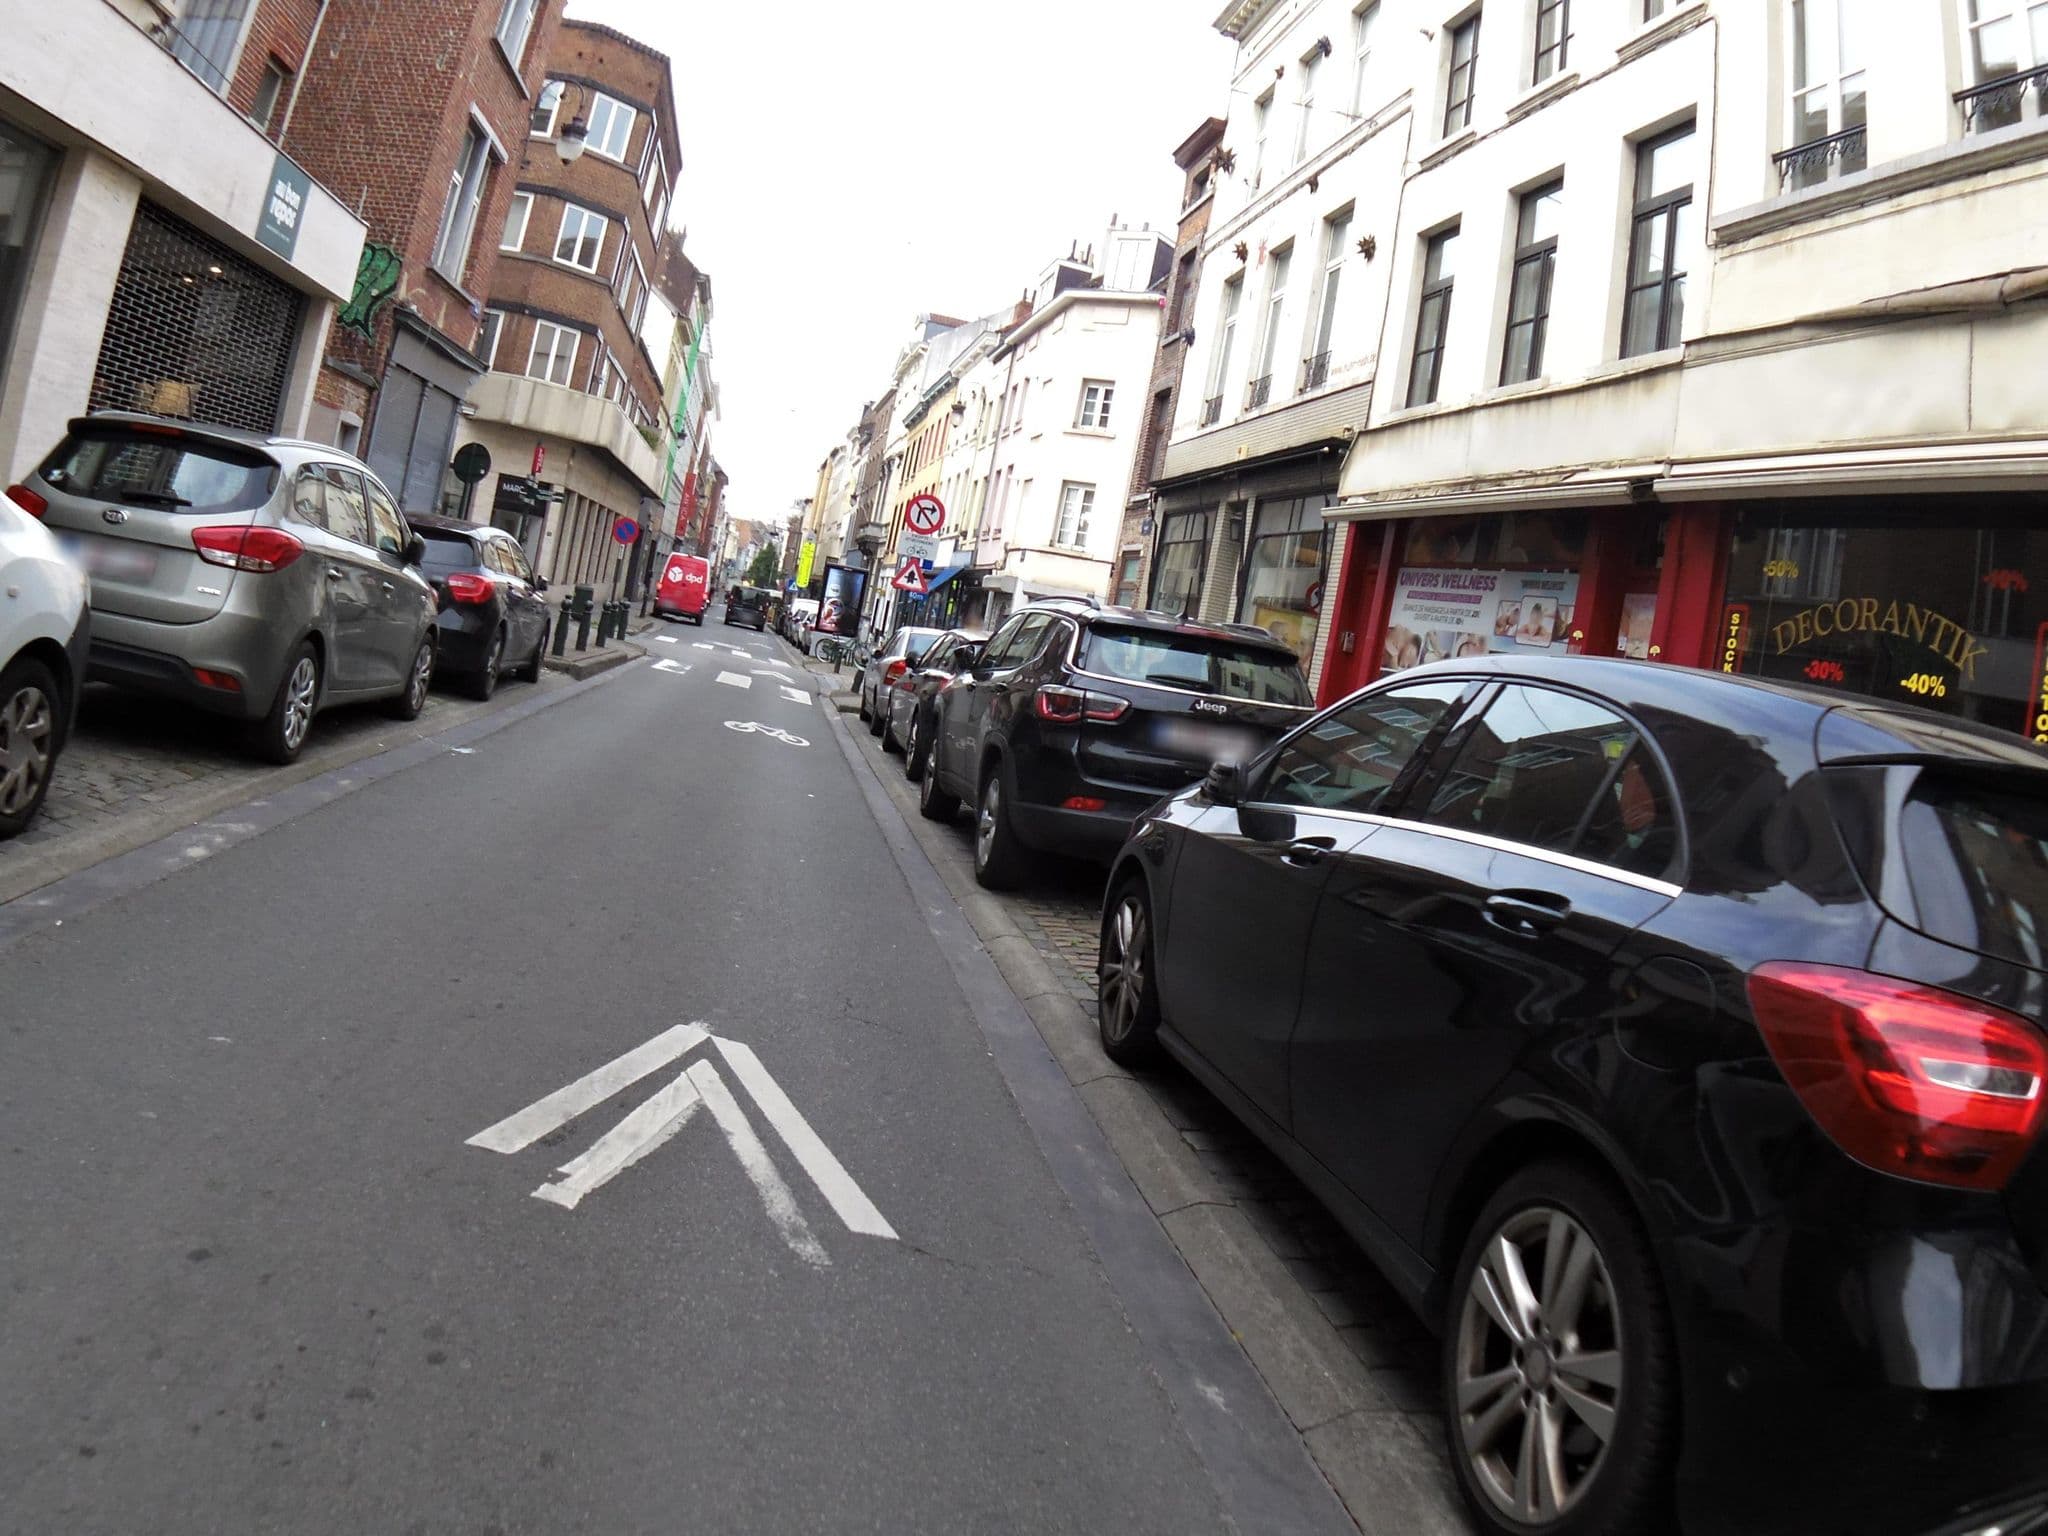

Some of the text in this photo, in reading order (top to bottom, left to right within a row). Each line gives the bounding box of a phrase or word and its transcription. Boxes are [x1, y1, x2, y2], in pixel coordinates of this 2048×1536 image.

[685, 572, 703, 584] dpd
[1400, 570, 1498, 592] UNIVERS WELLNESS
[1723, 612, 1741, 673] STOCK
[1772, 597, 1988, 681] DECORANTIK
[1803, 659, 1844, 682] -30%
[1900, 672, 1946, 698] -40%
[1195, 699, 1228, 715] Jeep
